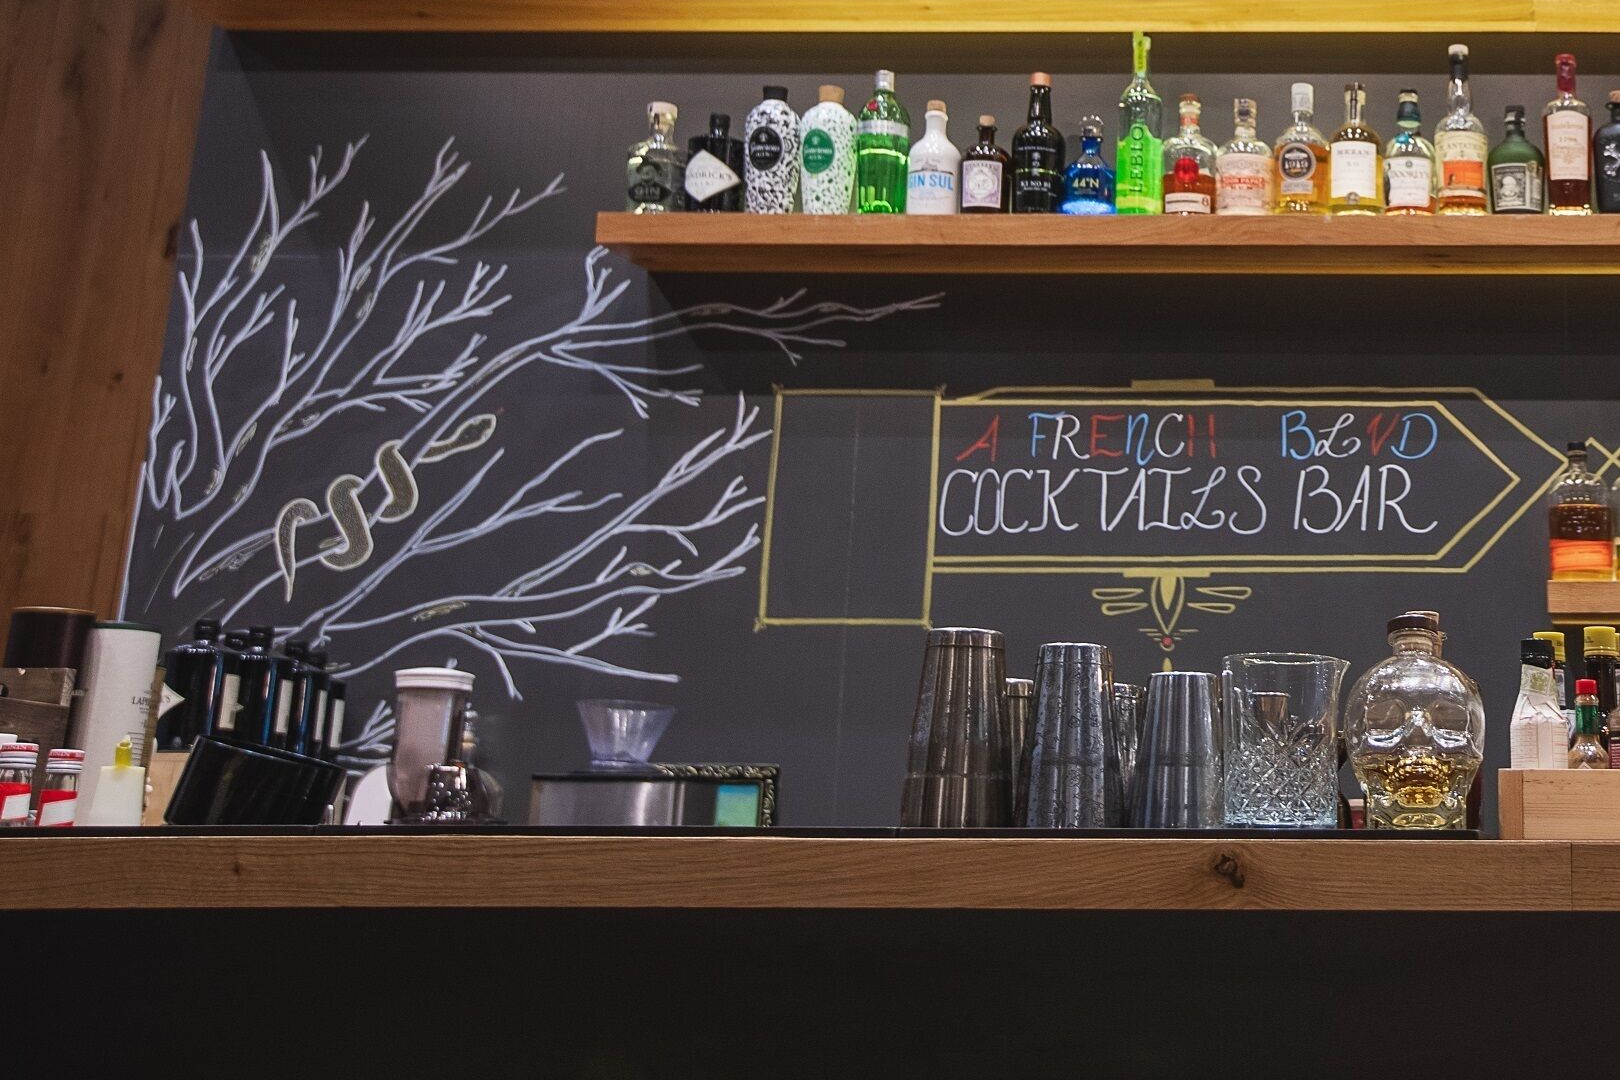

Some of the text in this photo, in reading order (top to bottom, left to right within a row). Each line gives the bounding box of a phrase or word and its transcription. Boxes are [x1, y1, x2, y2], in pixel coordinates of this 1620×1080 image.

[929, 174, 954, 191] SUL
[1129, 120, 1144, 194] LEBLO
[1201, 197, 1209, 207] 8
[956, 409, 1439, 465] A FRENCH BLVD
[938, 464, 1439, 537] COCKTAILS BAR
